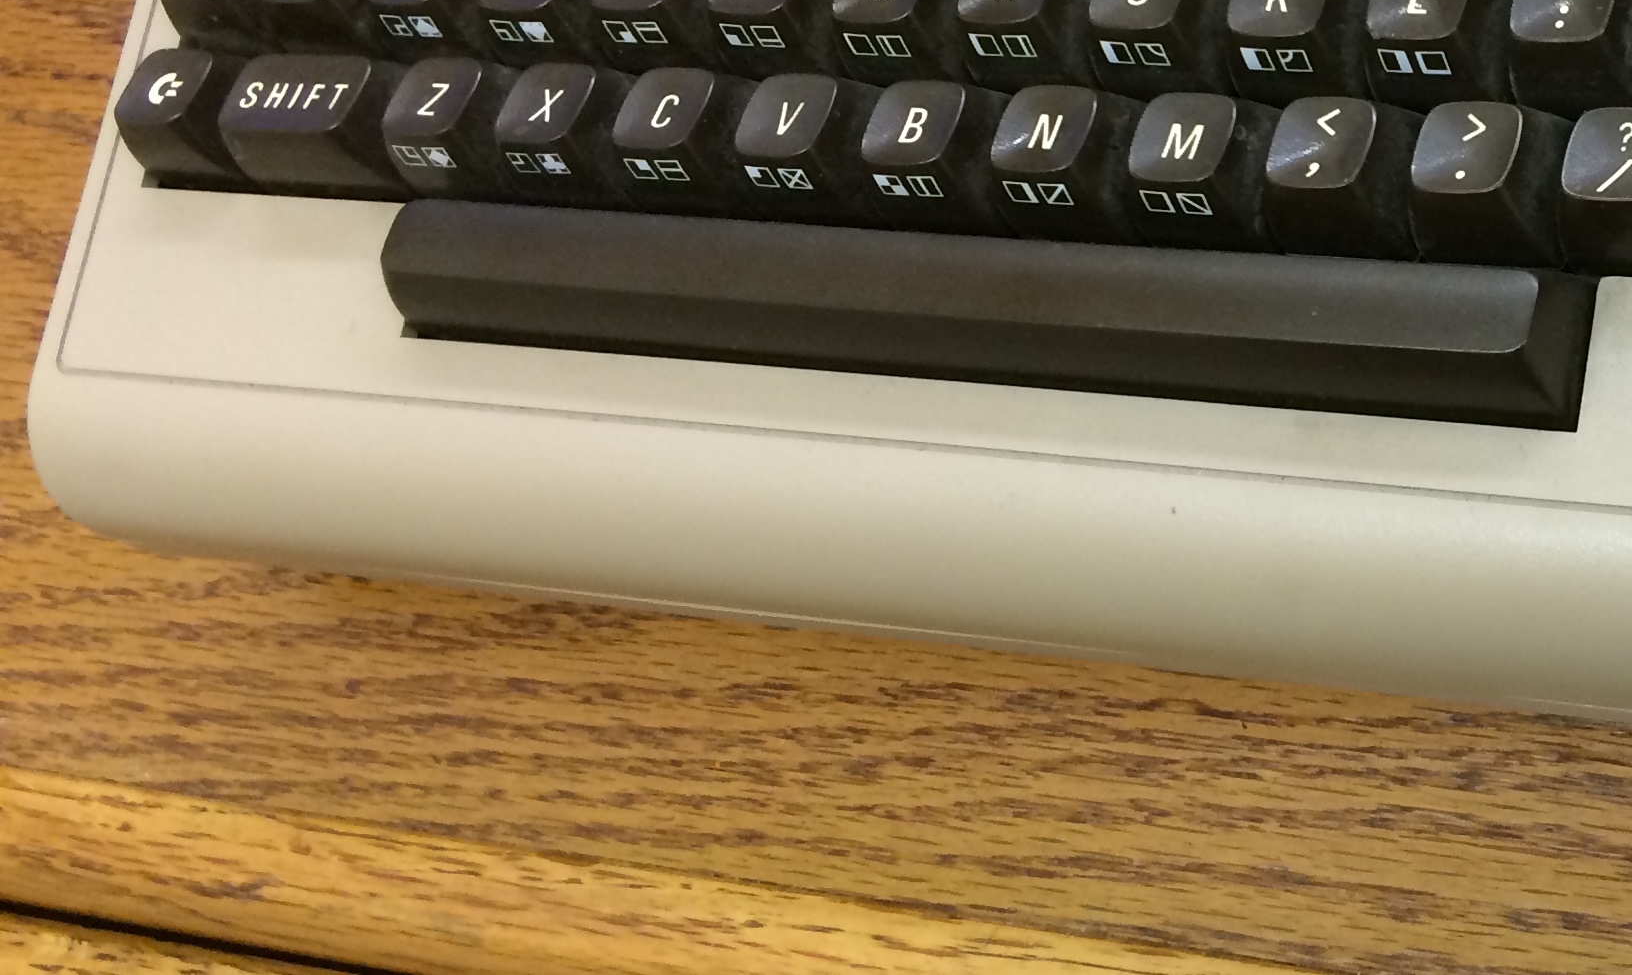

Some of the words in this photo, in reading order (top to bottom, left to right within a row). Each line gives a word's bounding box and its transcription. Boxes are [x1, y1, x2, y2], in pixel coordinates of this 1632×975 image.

[239, 81, 349, 110] SHIFT
[416, 82, 450, 117] Z
[528, 88, 564, 123] X
[650, 94, 680, 129] C
[776, 101, 804, 136] V
[897, 107, 928, 144] B
[1027, 113, 1064, 150] N
[1316, 108, 1341, 136] <
[1462, 113, 1487, 142] >
[1161, 123, 1205, 160] M
